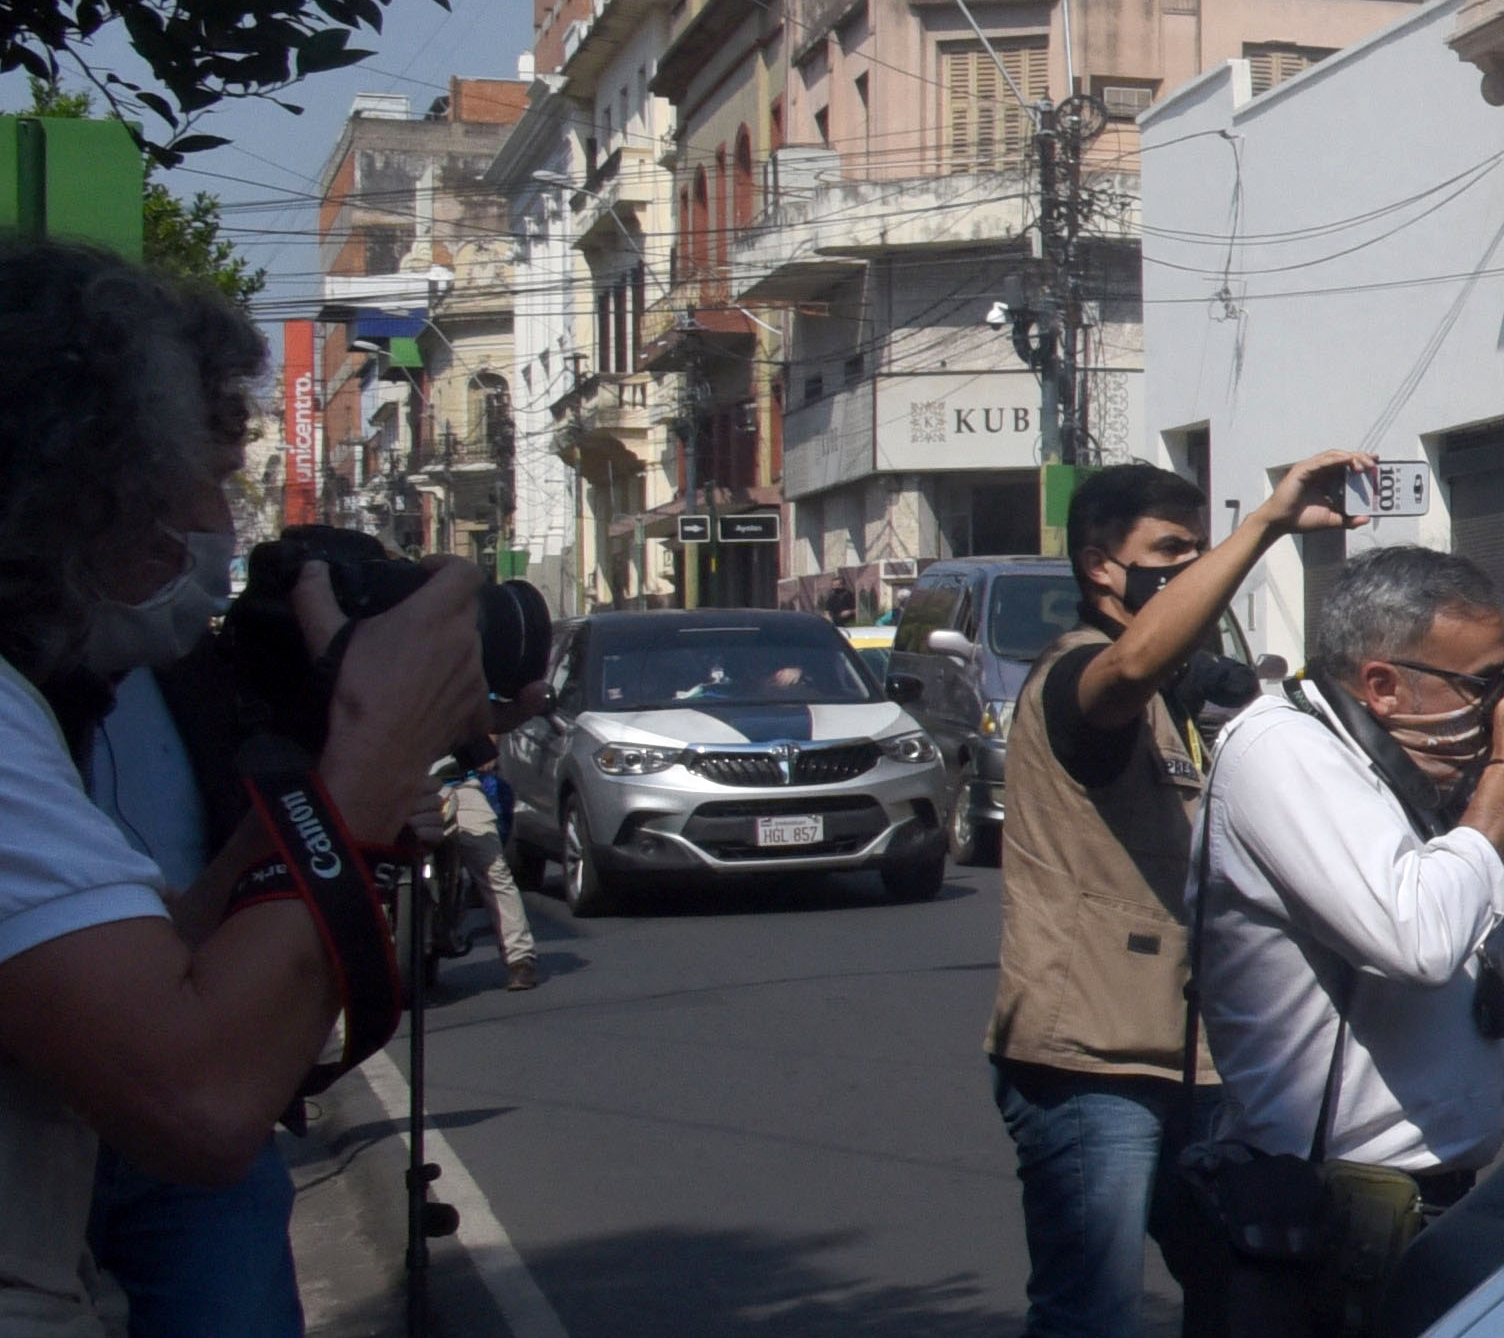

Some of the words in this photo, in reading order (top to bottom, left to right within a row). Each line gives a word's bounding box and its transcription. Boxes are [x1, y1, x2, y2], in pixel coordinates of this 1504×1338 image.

[953, 407, 1043, 434] KUB
[1380, 466, 1395, 512] 1000
[280, 790, 342, 879] Canon
[763, 828, 789, 844] HGL
[793, 826, 818, 842] 857
